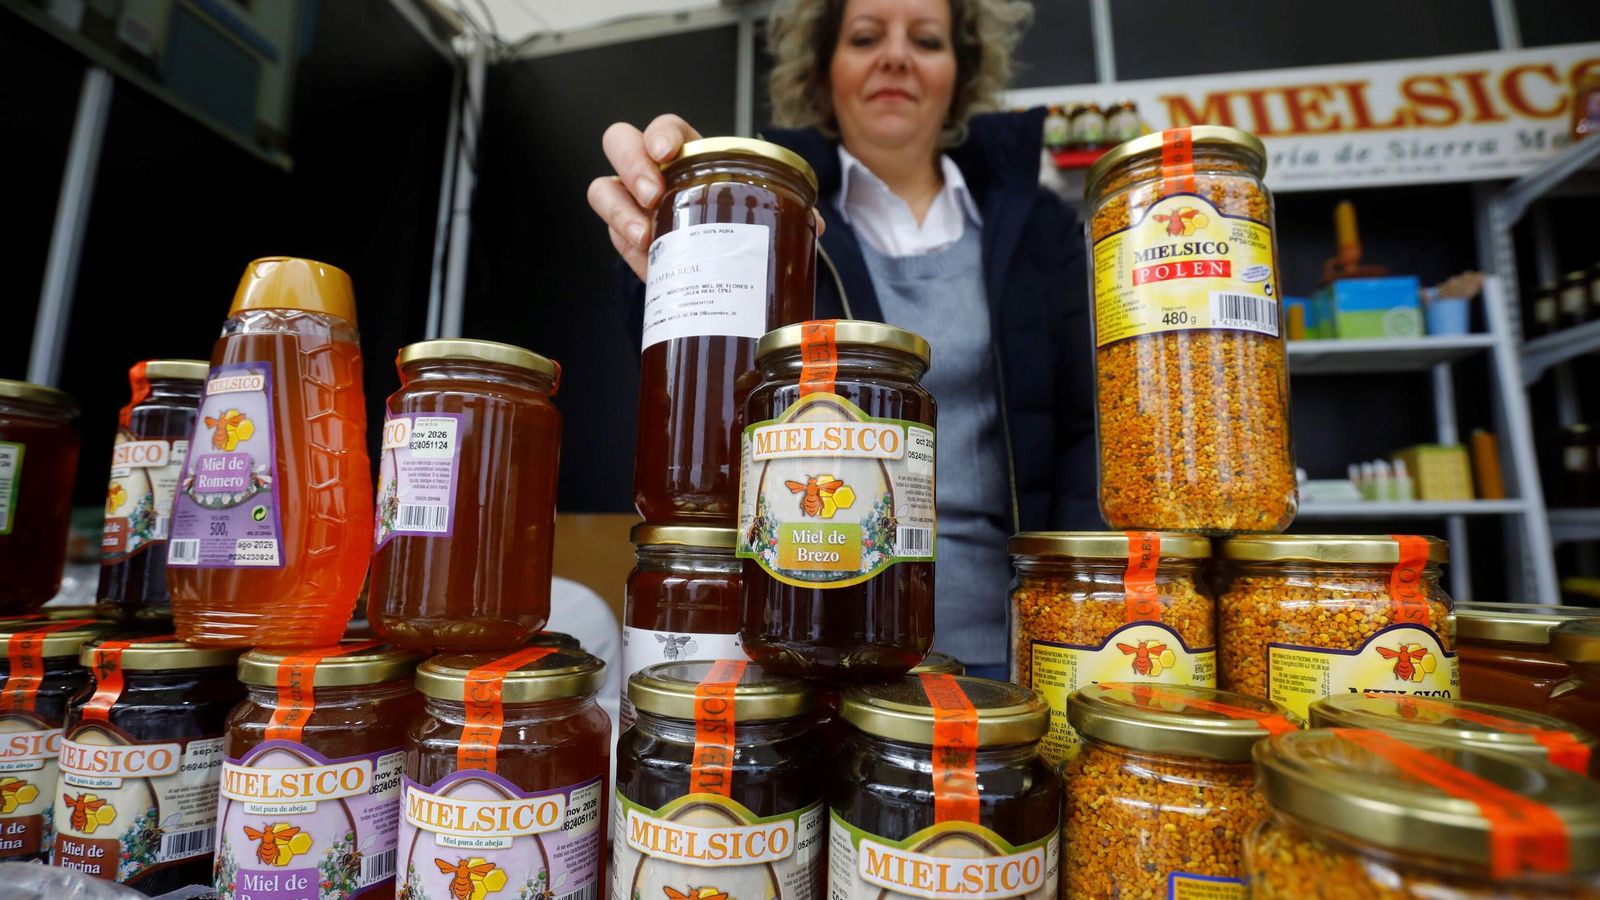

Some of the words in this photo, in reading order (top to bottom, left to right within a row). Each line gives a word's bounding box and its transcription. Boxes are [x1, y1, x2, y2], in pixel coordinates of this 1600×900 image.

[1273, 144, 1319, 166] ría
[1334, 141, 1369, 163] de
[1386, 133, 1498, 160] Sierra
[1514, 127, 1572, 149] Mo
[1134, 242, 1230, 264] MIELSICO
[678, 264, 702, 276] REAL
[1138, 262, 1225, 282] POLEN
[1162, 311, 1188, 325] 480
[208, 377, 261, 393] MIELSICO
[427, 430, 448, 439] 2026
[755, 426, 899, 455] MIELSICO
[201, 458, 225, 471] Miel
[228, 456, 244, 470] de
[199, 475, 244, 488] Romero
[237, 542, 252, 550] ago
[253, 540, 273, 549] 2026
[791, 528, 824, 545] Miel
[827, 529, 847, 545] de
[796, 546, 841, 563] Brezo
[1396, 568, 1425, 619] SICO
[464, 672, 497, 773] IELSICO
[61, 744, 172, 773] IELSICO
[193, 747, 211, 757] sep
[223, 766, 365, 798] MIELSICO
[374, 770, 391, 781] nov
[393, 766, 403, 775] 20
[95, 778, 113, 787] abeja
[368, 779, 401, 795] 0824051
[250, 804, 263, 812] Miel
[263, 806, 278, 814] pura
[278, 805, 288, 813] de
[288, 804, 307, 814] abeja
[408, 792, 560, 832] MIELSICO
[566, 807, 581, 817] nov
[582, 798, 598, 812] 2026
[7, 823, 27, 835] de
[806, 821, 816, 831] oct
[0, 838, 23, 849] ina
[442, 835, 457, 845] Miel
[457, 837, 475, 847] pura
[475, 838, 485, 847] de
[485, 838, 504, 848] abeja
[631, 815, 789, 860] MIELSICO
[62, 840, 85, 857] Miel
[87, 844, 104, 857] de
[62, 857, 101, 874] Encina
[865, 847, 1041, 894] MIELSICO
[243, 873, 279, 892] Miel
[284, 873, 308, 891] de
